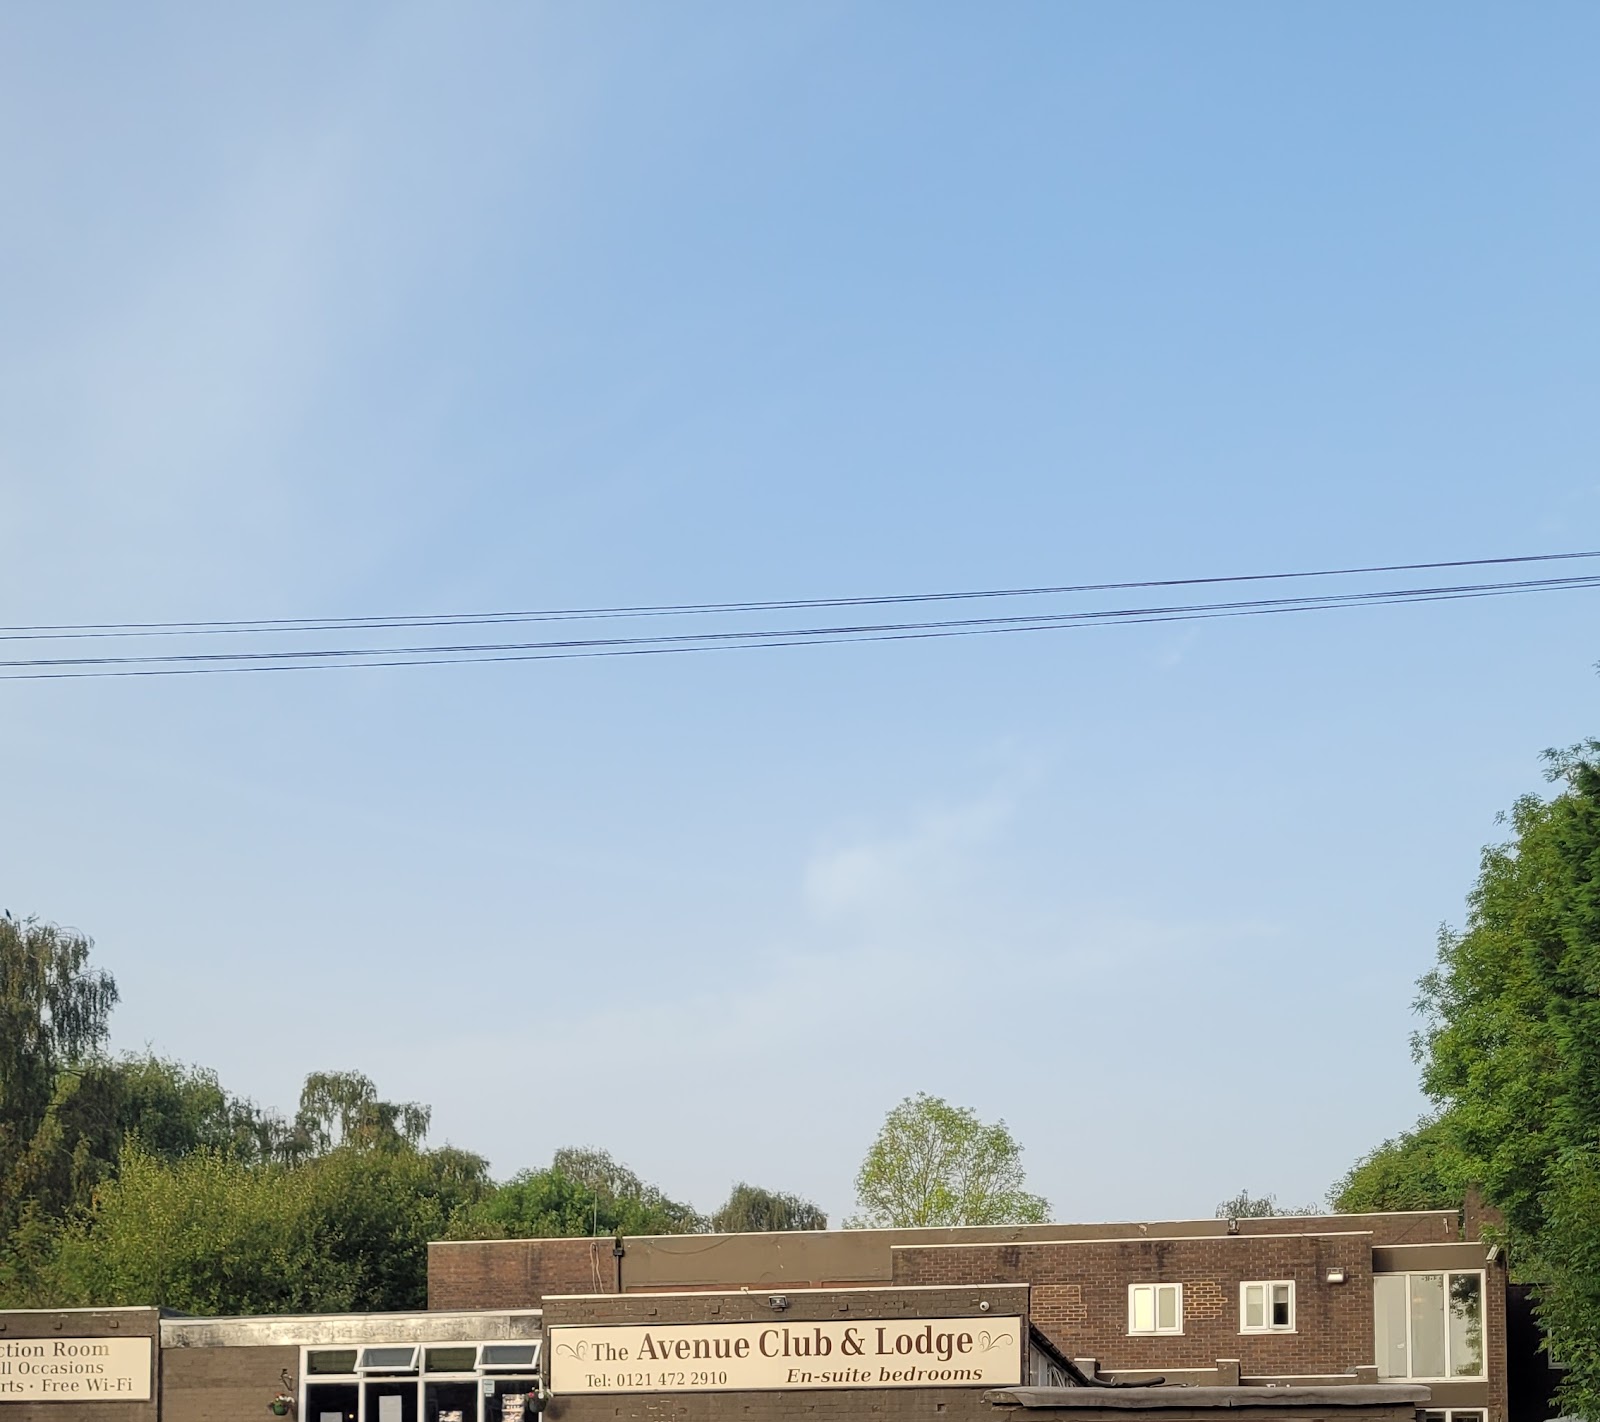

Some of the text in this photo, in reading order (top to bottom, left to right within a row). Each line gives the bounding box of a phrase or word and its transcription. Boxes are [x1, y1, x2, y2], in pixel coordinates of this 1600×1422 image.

[53, 1341, 110, 1357] Room
[591, 1325, 974, 1361] The Avenue Club & Lodge
[18, 1360, 104, 1375] Occasions
[42, 1378, 80, 1392] Free
[86, 1377, 133, 1392] Wi-Fi
[585, 1366, 983, 1387] Tel: 0121 472 2910 En-suite bedrooms
